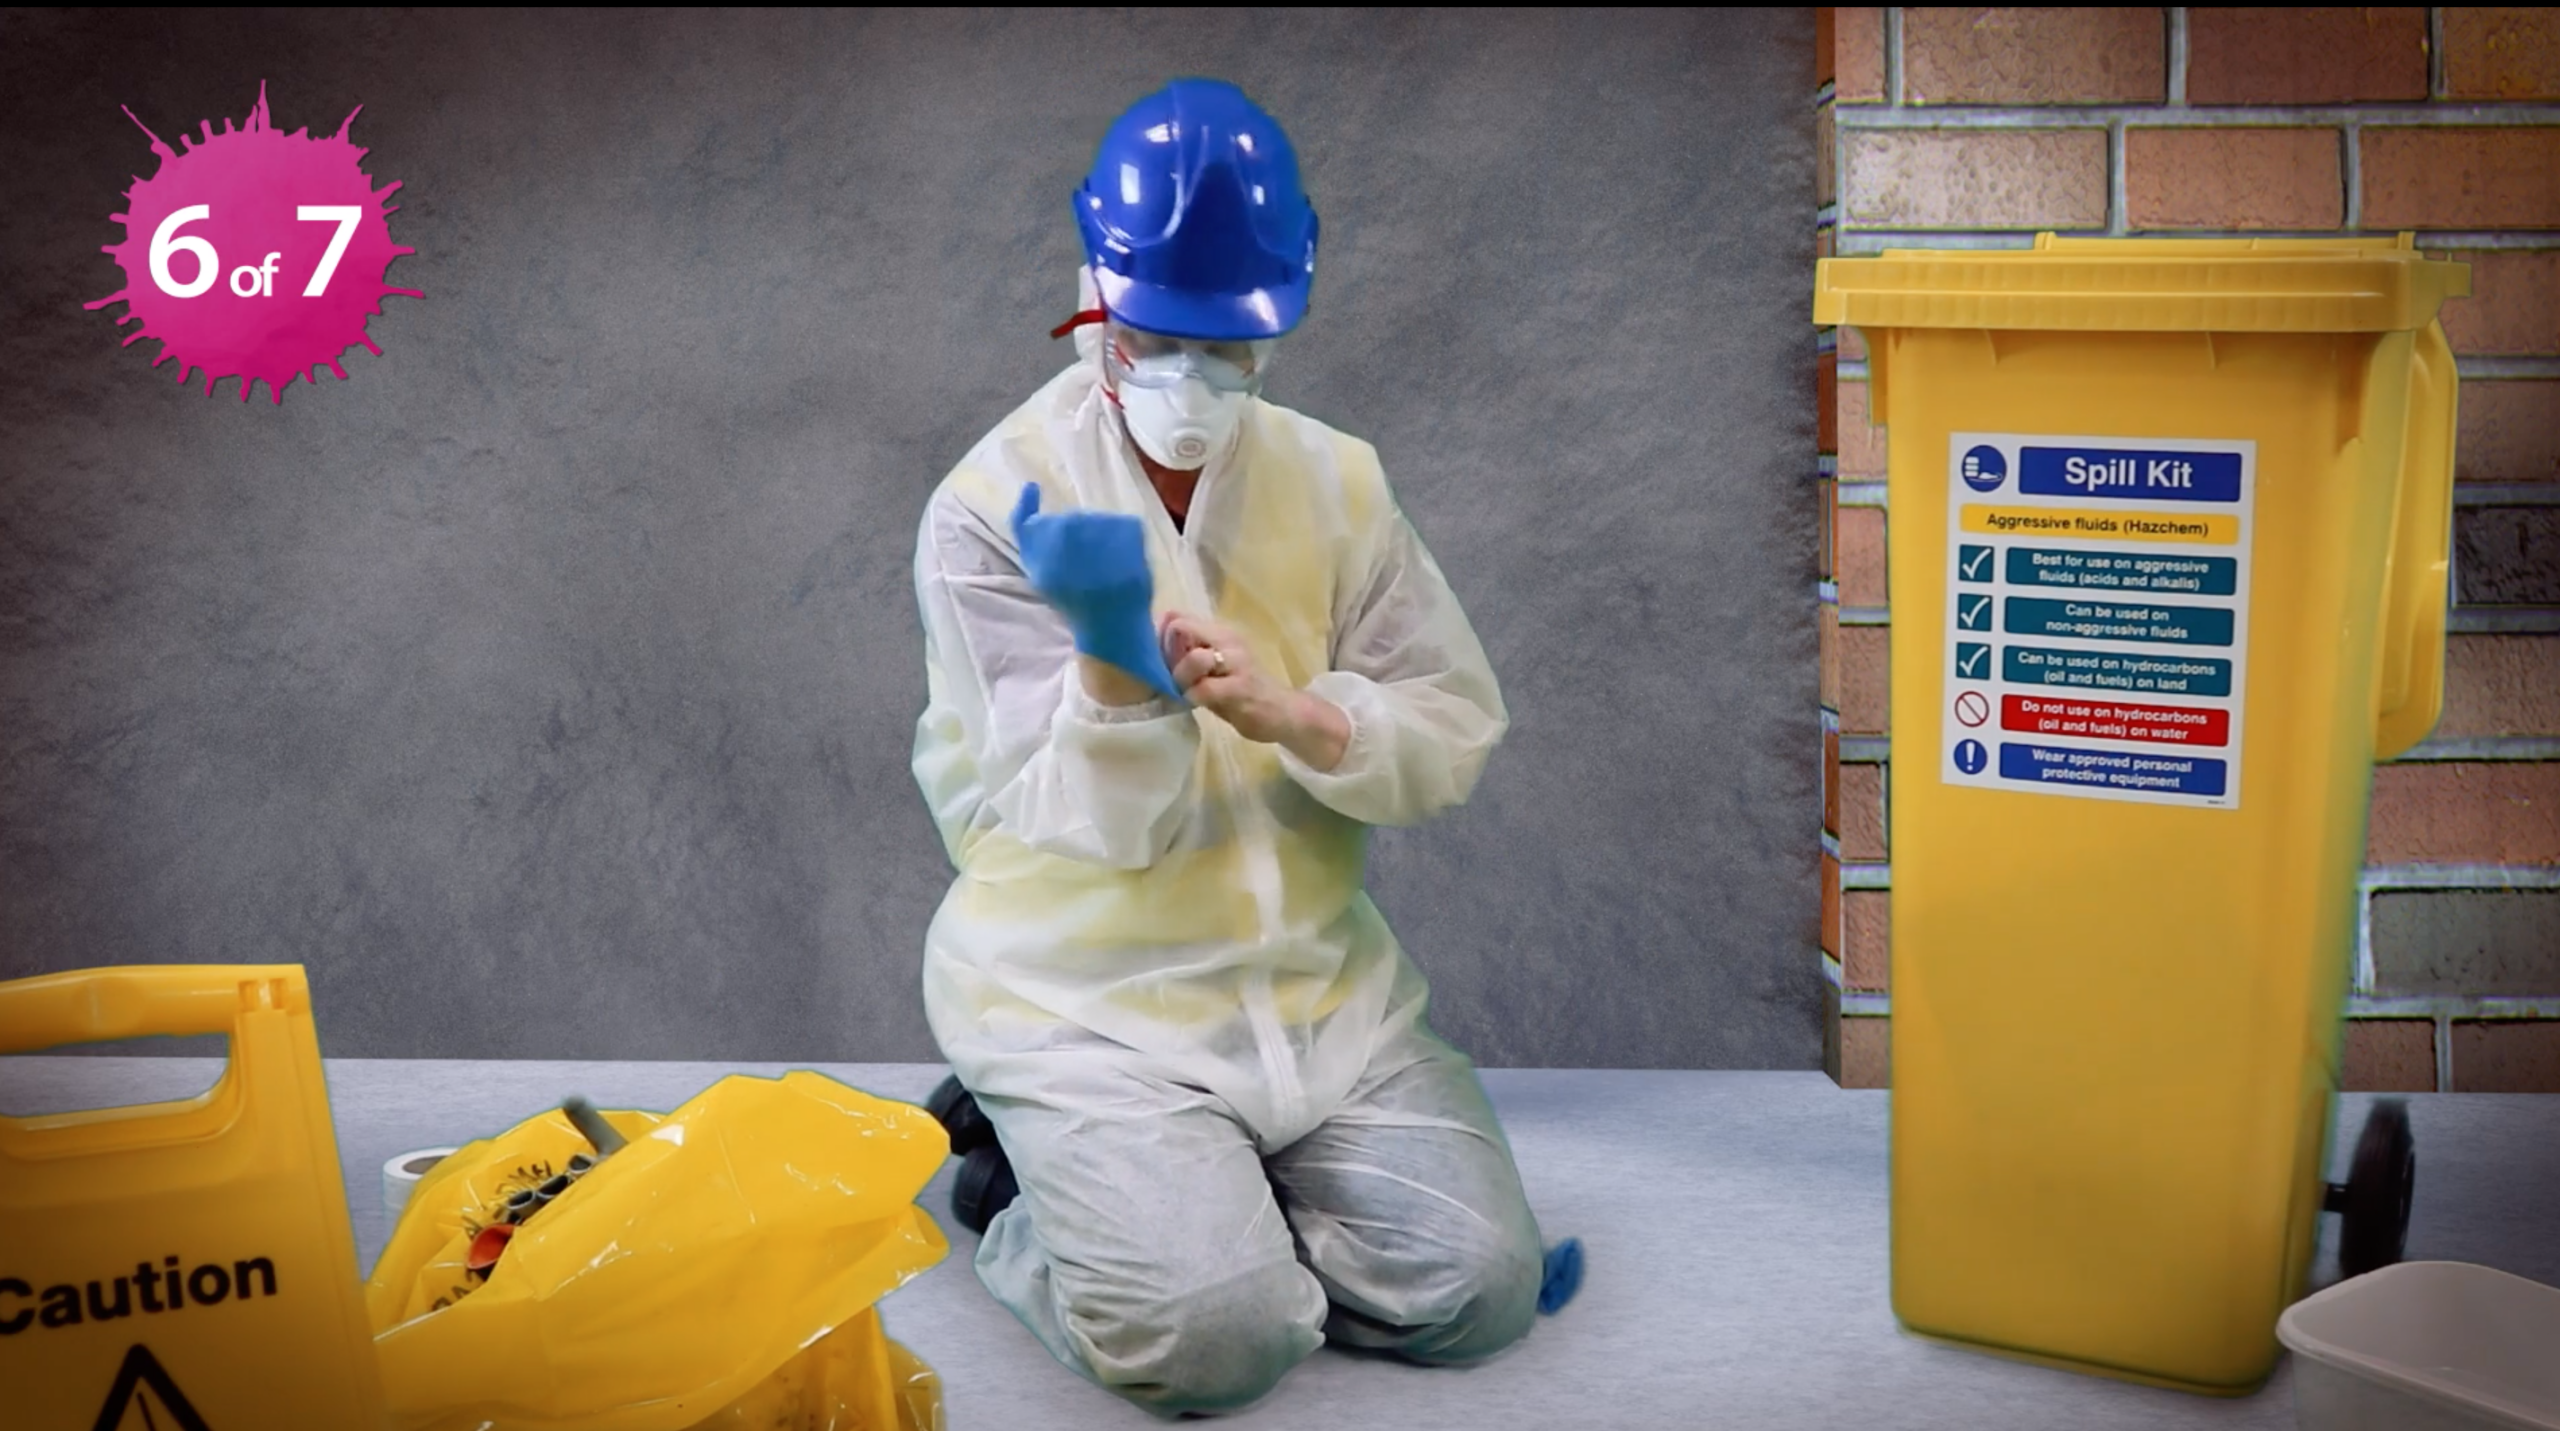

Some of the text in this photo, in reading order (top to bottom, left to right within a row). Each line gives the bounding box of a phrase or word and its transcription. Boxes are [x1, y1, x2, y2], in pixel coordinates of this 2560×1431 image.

[2065, 457, 2193, 492] Spill Kit
[1987, 513, 2209, 537] Aggressive fluids (Hazchem)
[2033, 553, 2209, 573] Best for use on aggressive
[2039, 570, 2200, 590] fluids (acids and alkalis)
[2066, 604, 2169, 621] Can be used on
[2046, 621, 2188, 639] non-aggressive fluids
[2018, 652, 2216, 676] Can be used on hydrocarbons
[2044, 671, 2187, 690] (oil and fuels) on land
[2022, 701, 2207, 724] Do not use on hydrocarbons
[2038, 719, 2188, 739] (oil and fuels) on water
[2032, 749, 2192, 772] Wear approved personal
[2042, 767, 2180, 788] protective equipment
[0, 1256, 277, 1334] Caution
